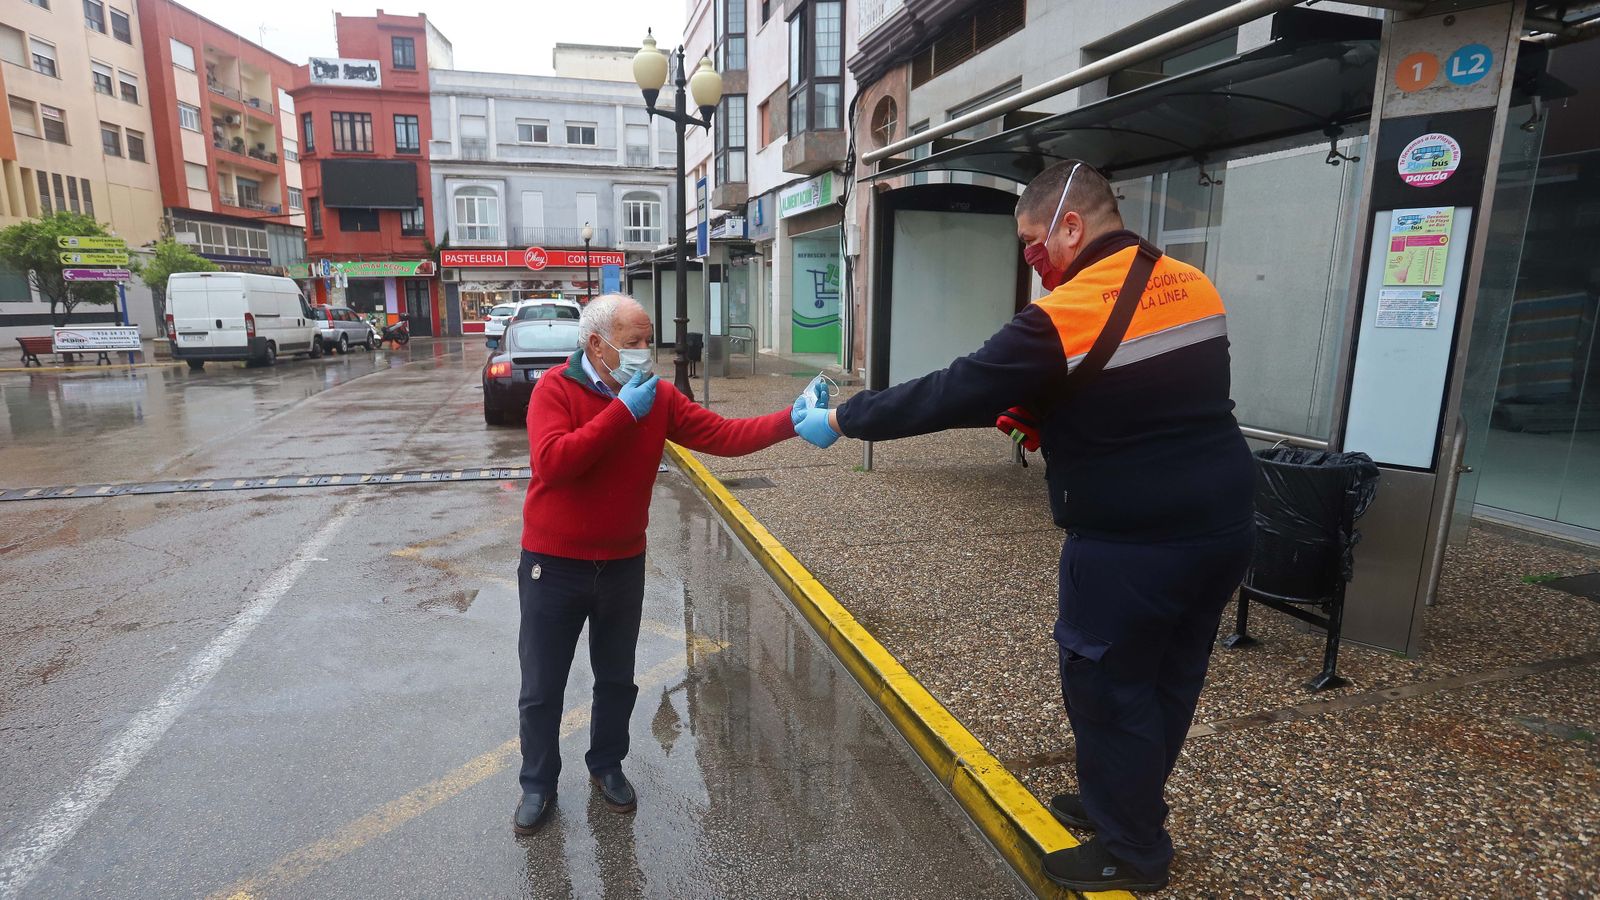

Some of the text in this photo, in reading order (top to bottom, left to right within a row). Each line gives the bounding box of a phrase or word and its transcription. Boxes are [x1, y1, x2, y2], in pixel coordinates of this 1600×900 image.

[1412, 62, 1423, 82] 1
[1452, 53, 1485, 77] L2
[1403, 138, 1425, 159] llevamos
[1437, 135, 1453, 145] Playa
[1405, 171, 1448, 184] parada
[445, 254, 503, 264] PASTELERIA
[526, 252, 546, 267] Okay
[567, 255, 622, 264] CONFITERIA
[1179, 271, 1202, 284] CIVIL
[1140, 287, 1189, 311] LA LÍNEA
